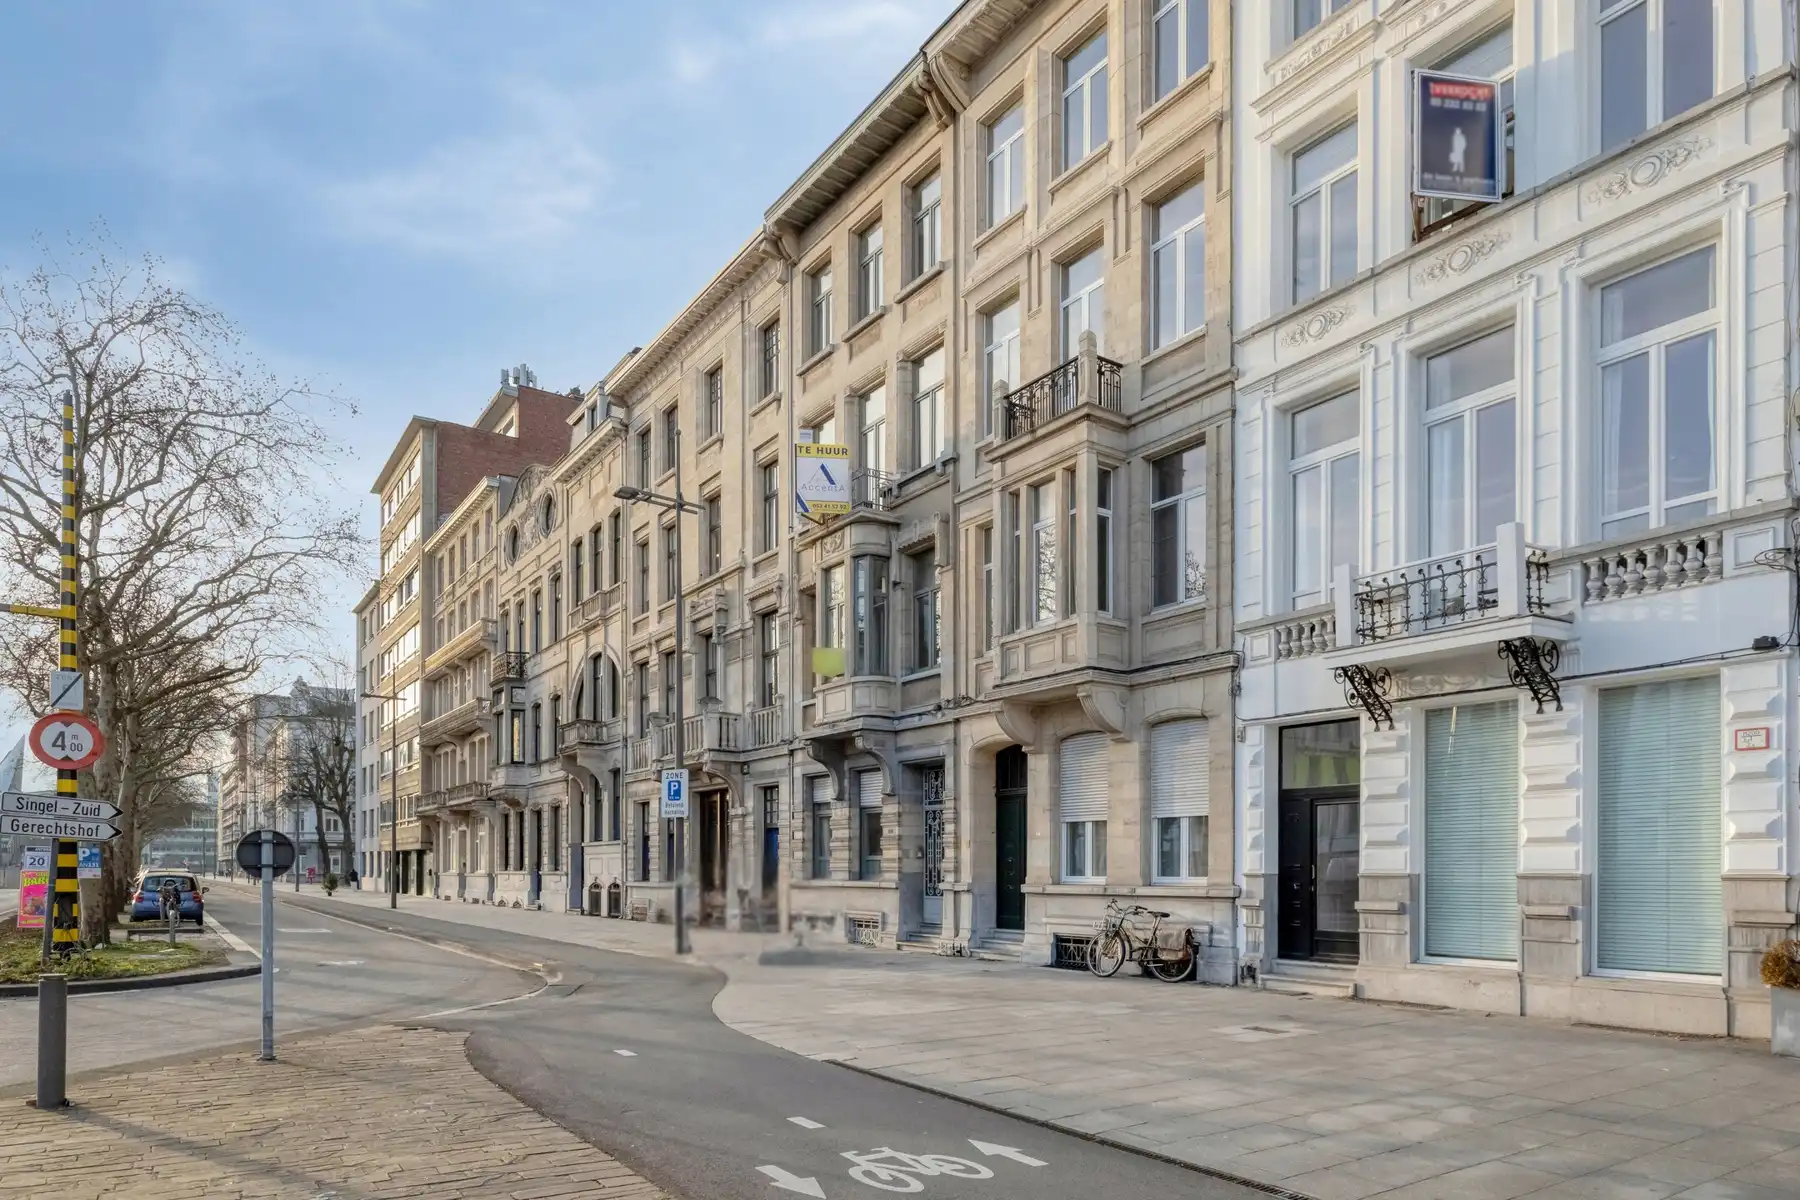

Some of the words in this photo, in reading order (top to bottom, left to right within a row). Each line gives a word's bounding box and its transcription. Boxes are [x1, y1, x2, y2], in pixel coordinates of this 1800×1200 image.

[798, 446, 811, 454] TE
[816, 447, 848, 455] HUUR
[51, 731, 66, 751] 4
[70, 743, 83, 752] 00
[16, 797, 58, 815] Singel
[72, 802, 101, 816] Zuid
[11, 819, 100, 837] Gerechtshof
[29, 857, 45, 866] 20
